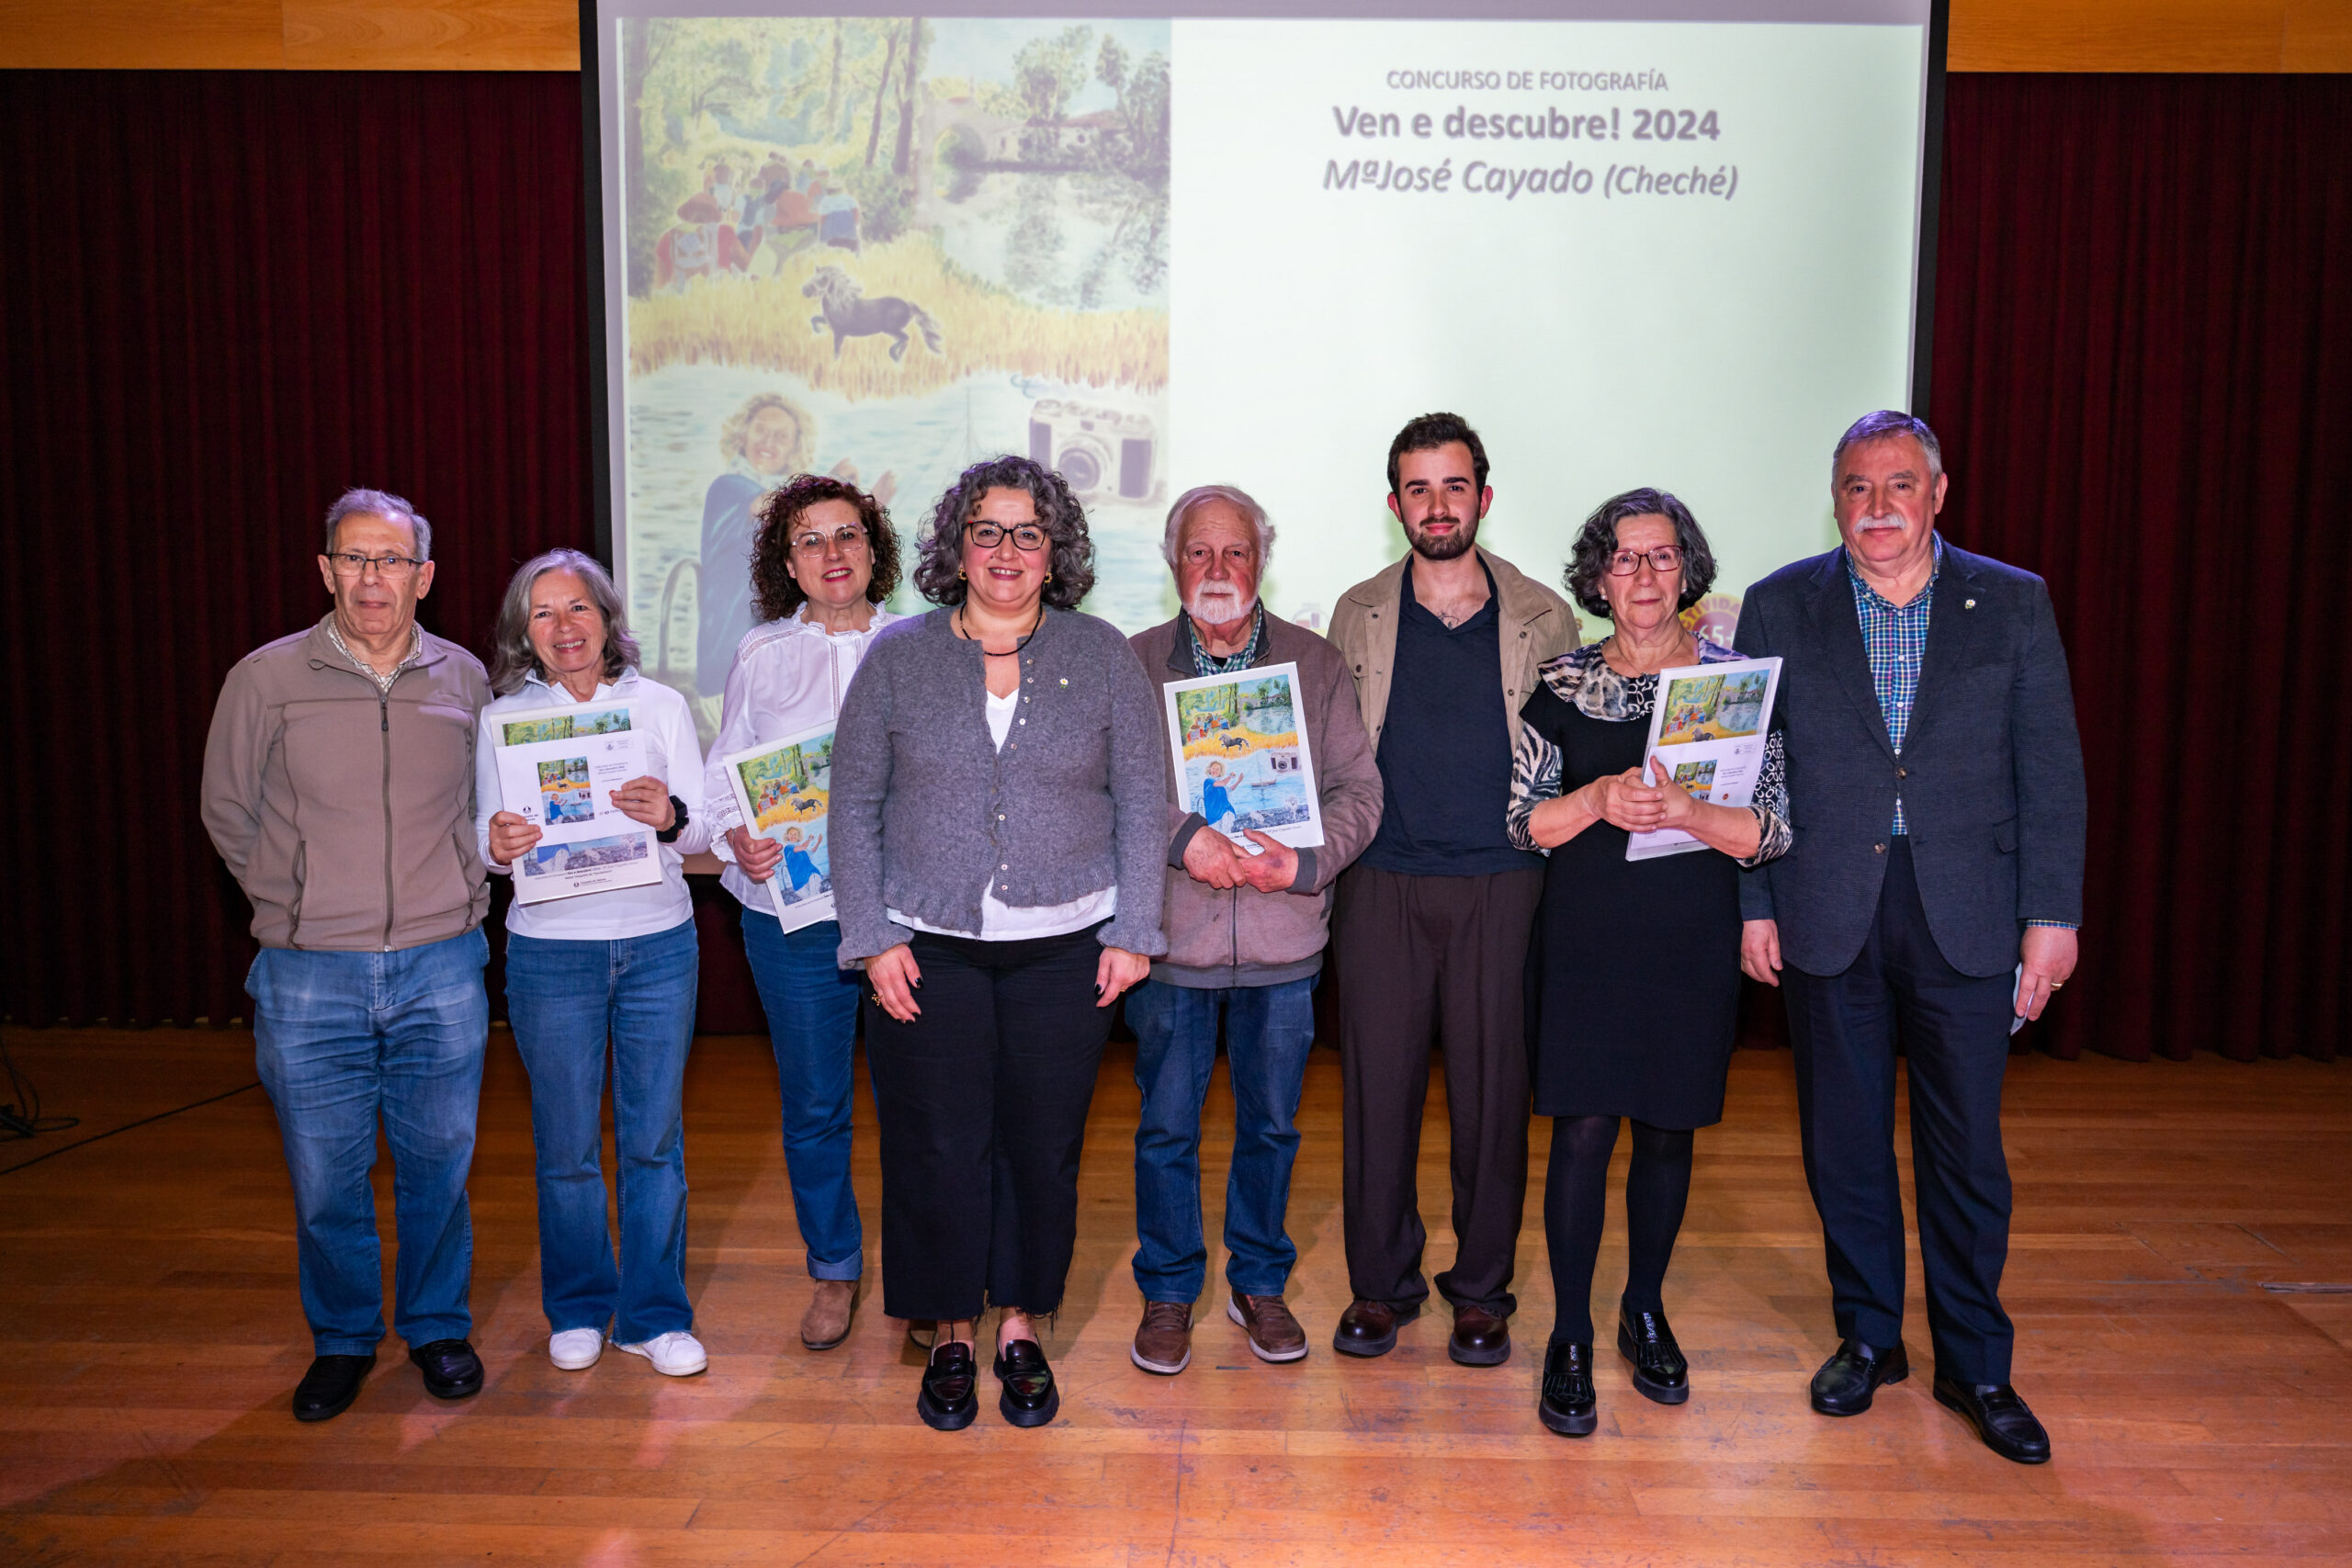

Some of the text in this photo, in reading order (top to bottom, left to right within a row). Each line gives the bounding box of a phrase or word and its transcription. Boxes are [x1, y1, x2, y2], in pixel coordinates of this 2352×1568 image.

[1386, 68, 1668, 91] CONCURSO DE FOTOGRAFÍA
[1332, 105, 1722, 141] Ven e descubre! 2024
[1462, 160, 1594, 201] Cayado
[1603, 164, 1738, 201] (Cheché)
